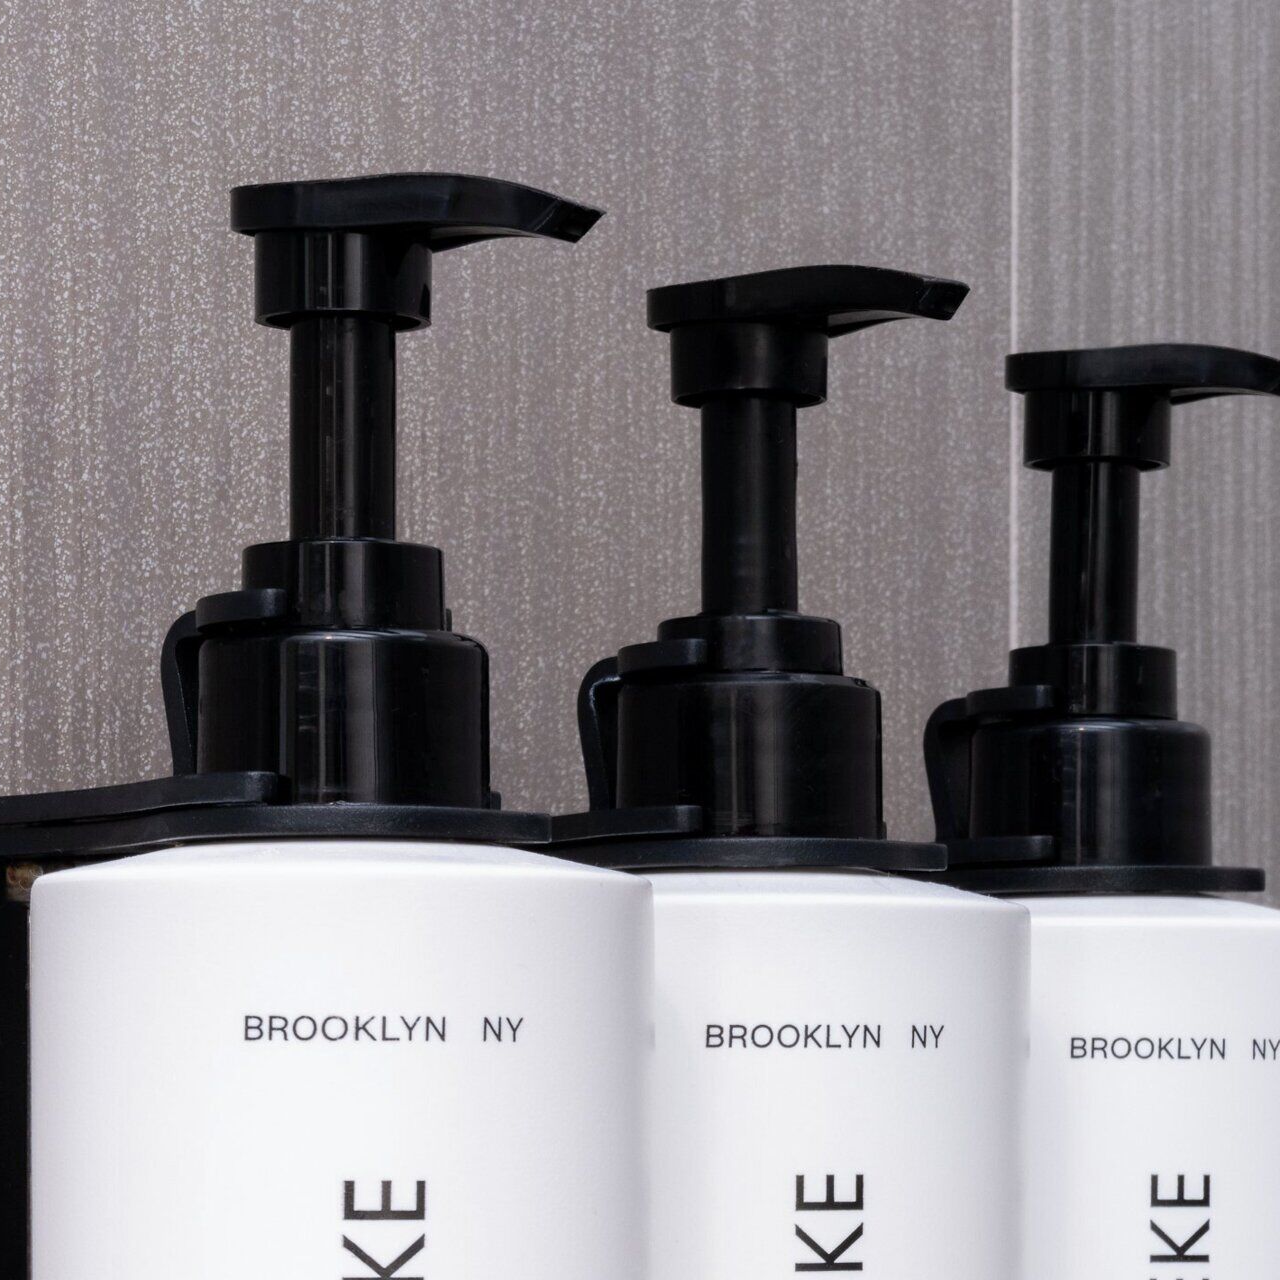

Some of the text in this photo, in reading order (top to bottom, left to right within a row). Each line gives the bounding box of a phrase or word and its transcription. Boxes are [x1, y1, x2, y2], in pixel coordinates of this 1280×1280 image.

[242, 1013, 525, 1044] BROOKLYN NY
[704, 1023, 945, 1050] BROOKLYN NY
[1069, 1035, 1227, 1061] BROOKLYN
